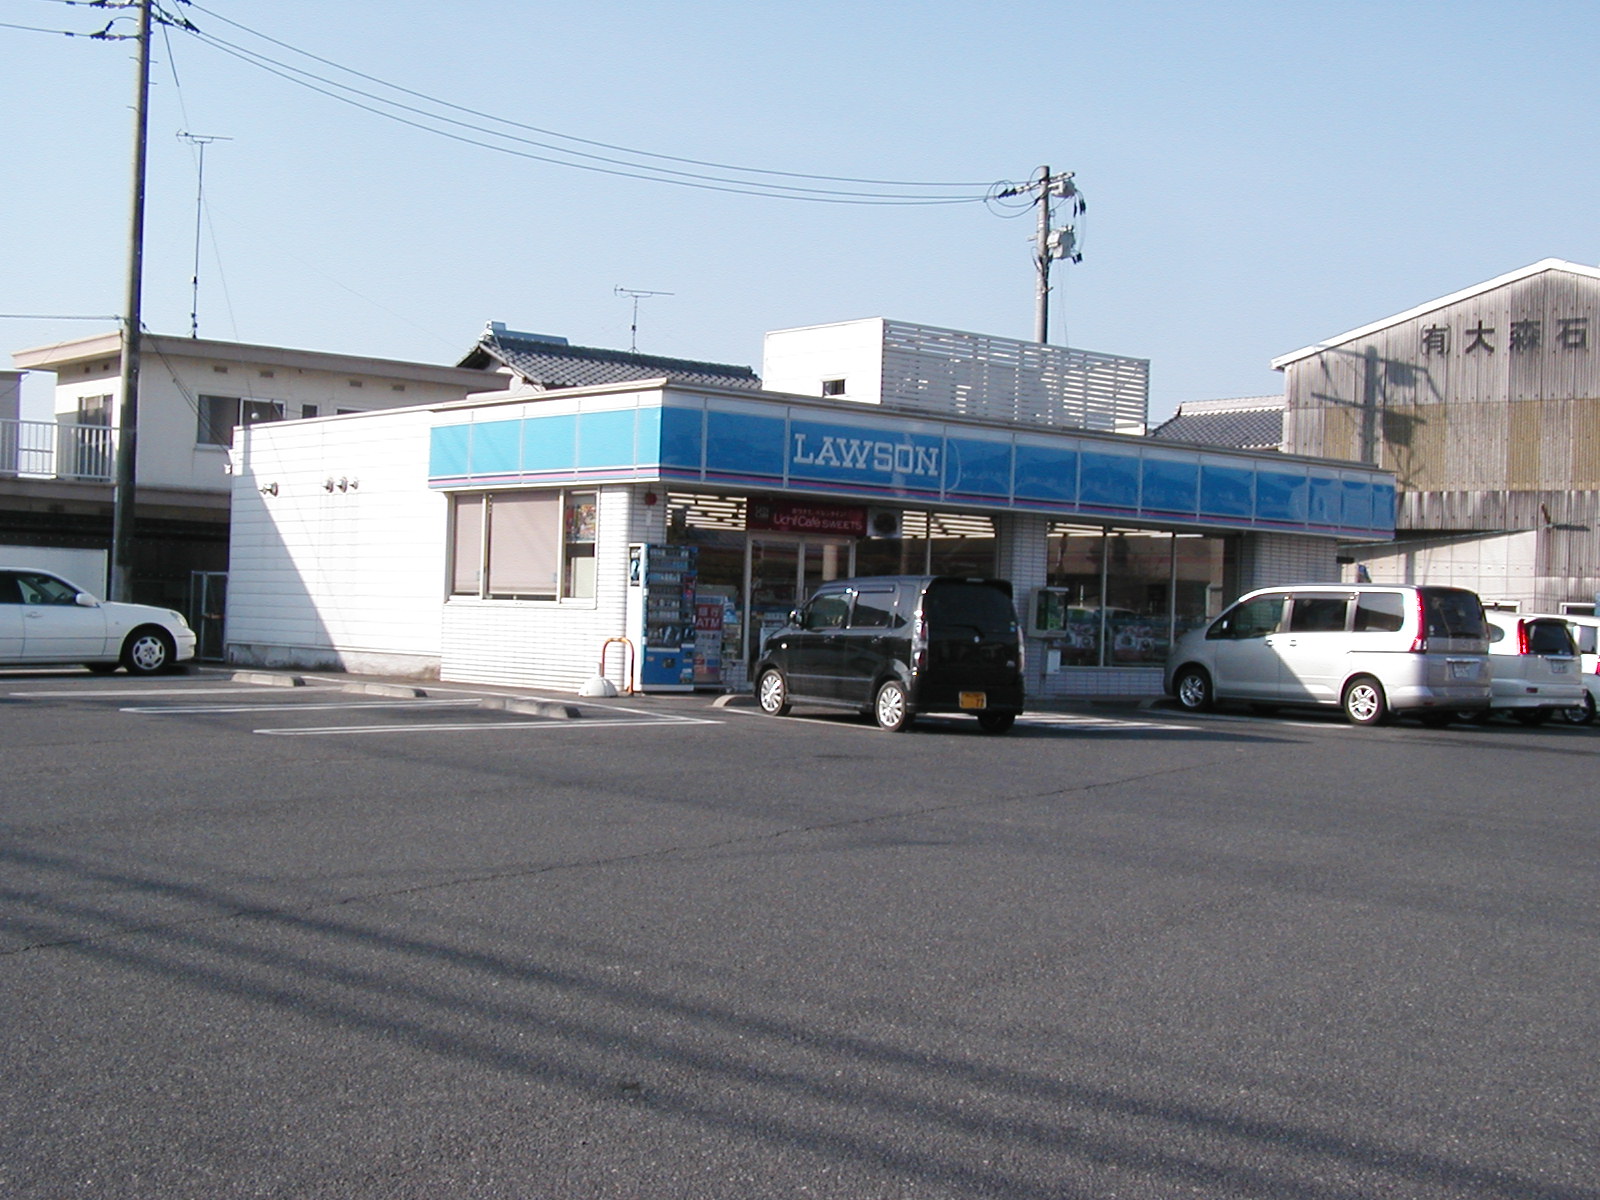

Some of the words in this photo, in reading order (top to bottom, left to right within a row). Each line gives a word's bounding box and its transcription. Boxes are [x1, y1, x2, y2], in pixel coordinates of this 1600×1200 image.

[793, 433, 939, 477] LAWSON
[822, 519, 863, 530] SWEETS
[696, 617, 720, 628] ATM
